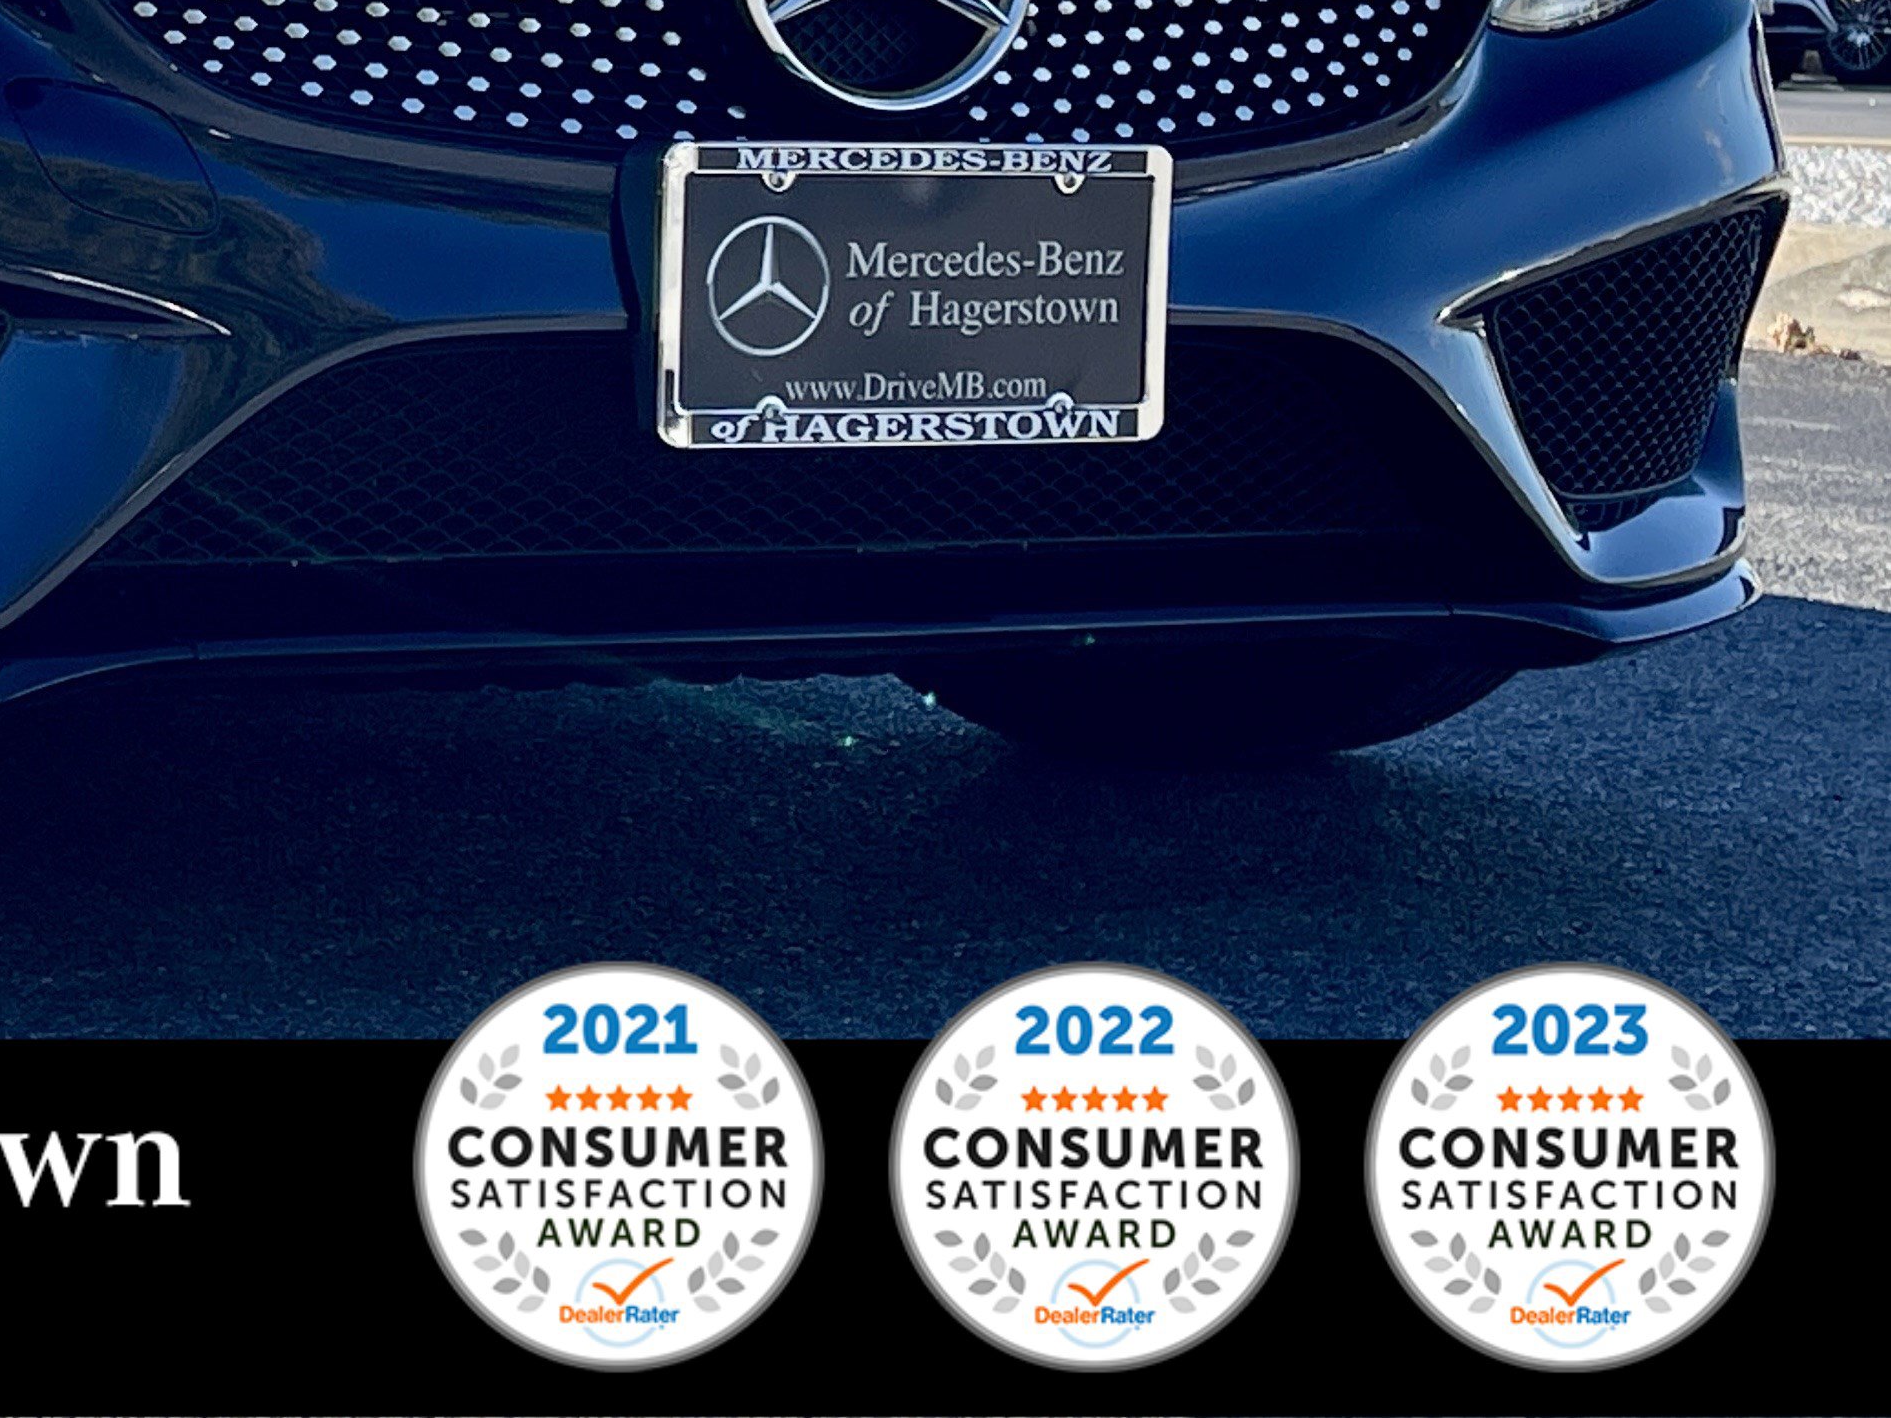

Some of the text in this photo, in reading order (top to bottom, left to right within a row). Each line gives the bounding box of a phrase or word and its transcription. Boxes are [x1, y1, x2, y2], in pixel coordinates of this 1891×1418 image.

[736, 148, 1114, 172] MERCEDES-BENZ
[845, 241, 1125, 279] Mercedes-Benz
[849, 290, 1119, 336] of Hagerstown
[784, 372, 1048, 402] www.DriveMB.com
[710, 409, 1121, 443] of HAGERSTOWN
